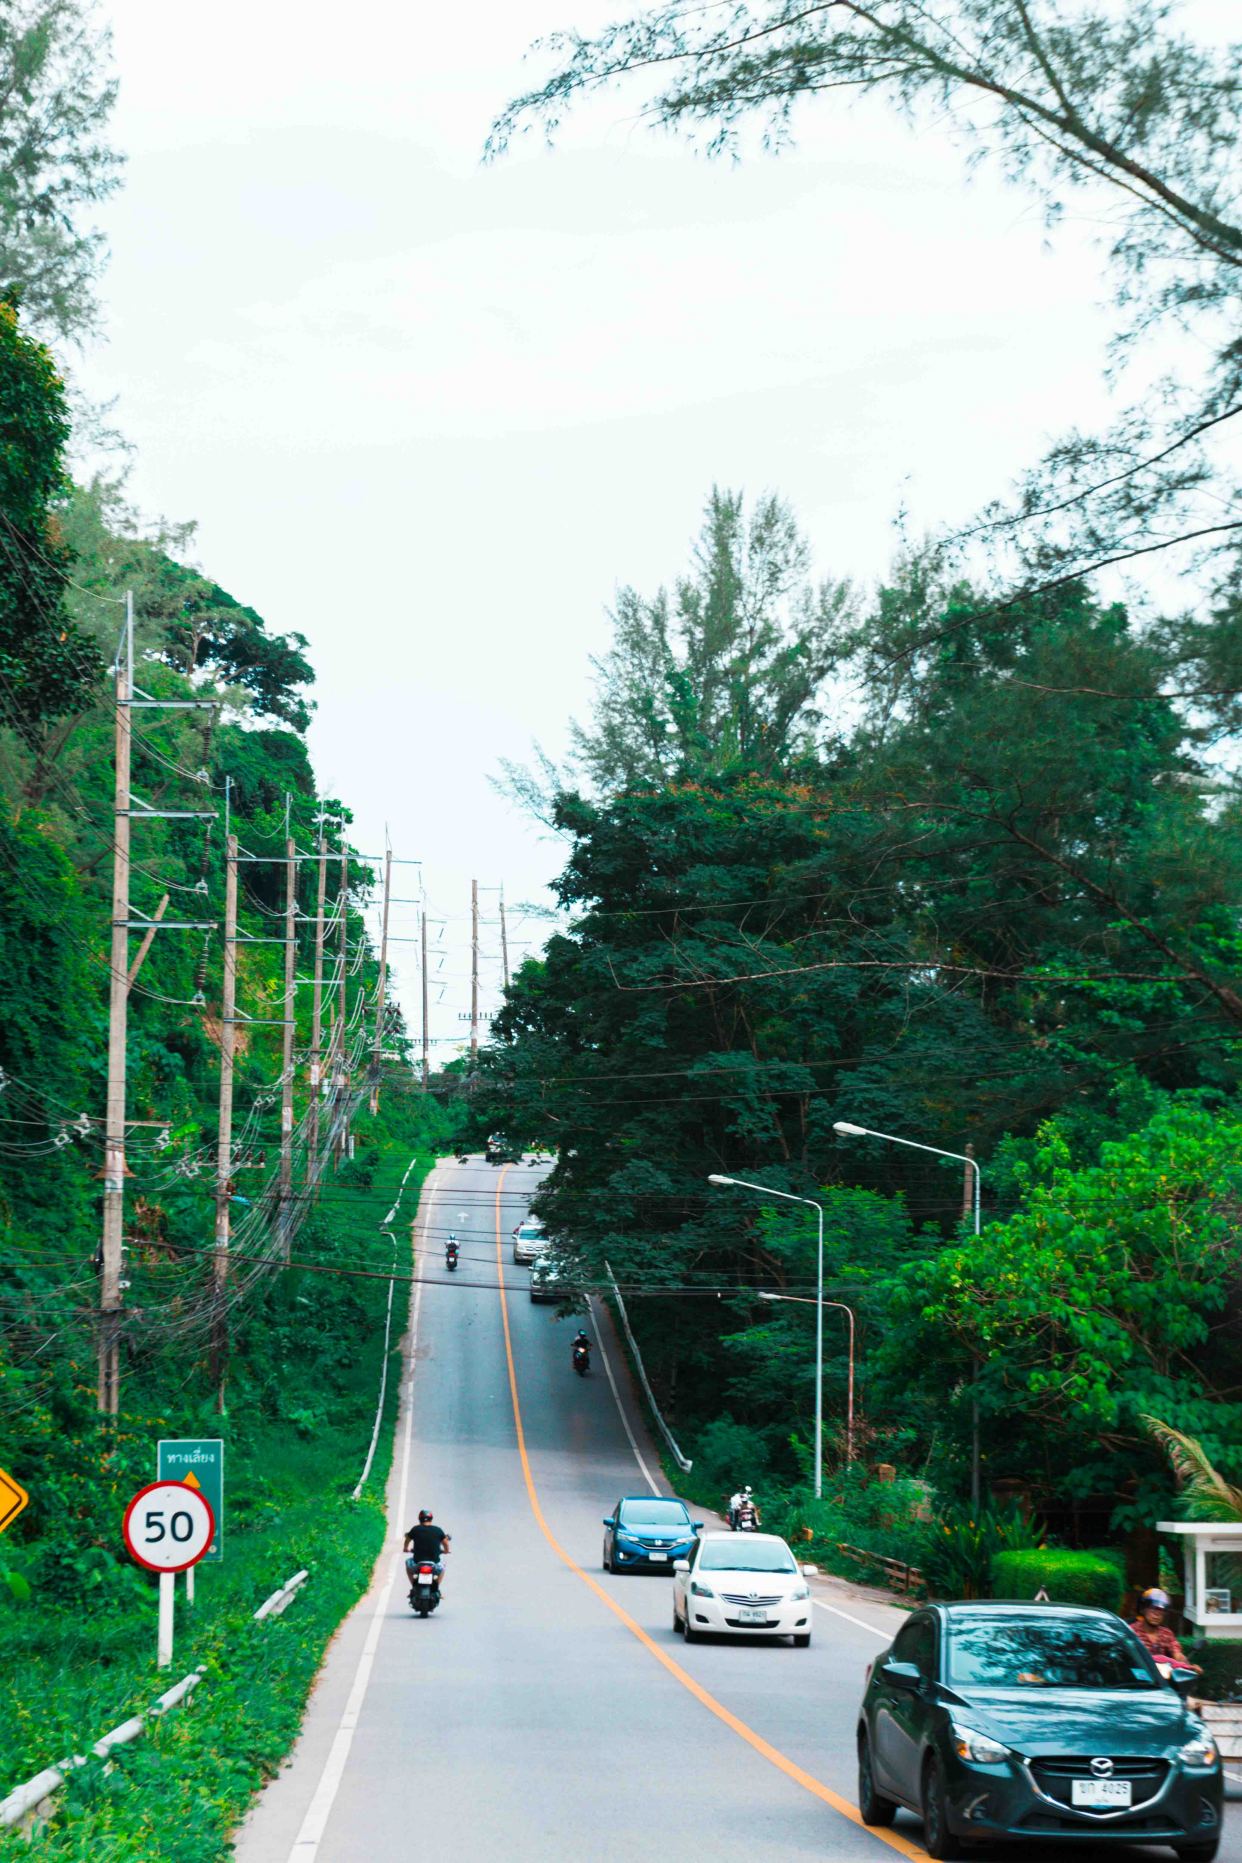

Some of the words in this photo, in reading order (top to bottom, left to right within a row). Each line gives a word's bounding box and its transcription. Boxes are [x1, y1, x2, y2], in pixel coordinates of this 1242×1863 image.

[166, 1446, 215, 1463] ทางเลี่ยง
[145, 1511, 193, 1543] 50
[1102, 1782, 1128, 1795] 4025
